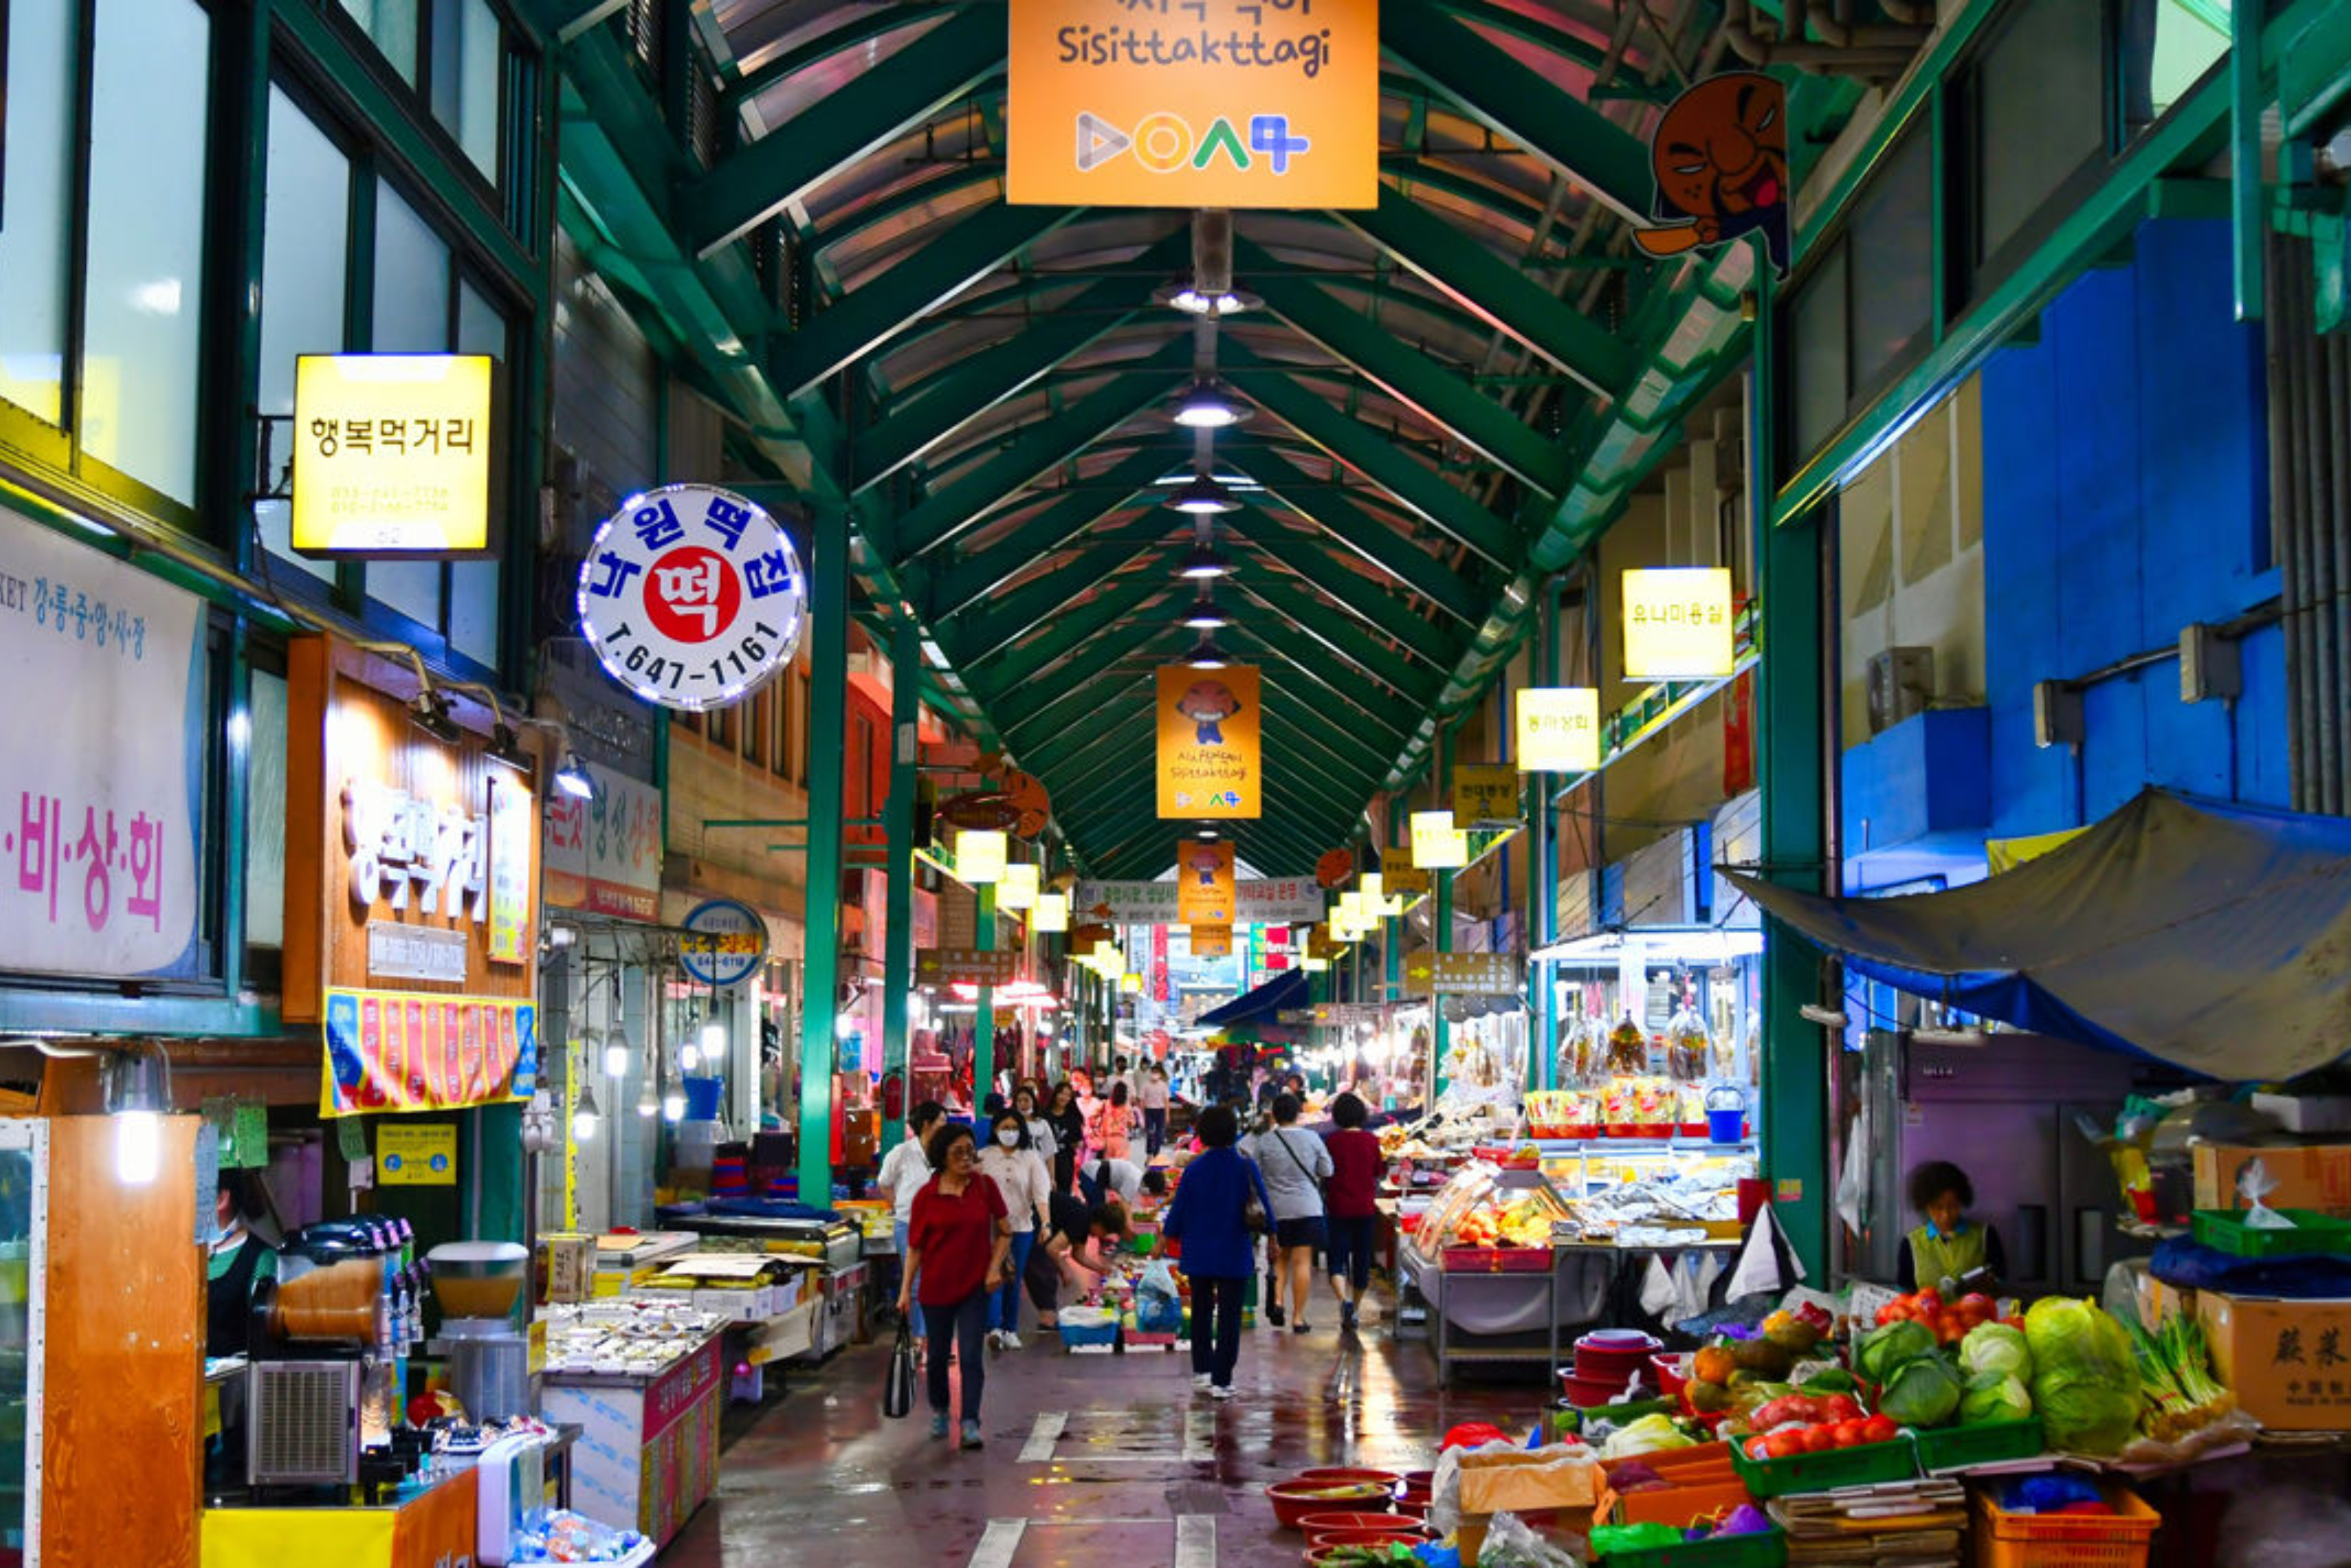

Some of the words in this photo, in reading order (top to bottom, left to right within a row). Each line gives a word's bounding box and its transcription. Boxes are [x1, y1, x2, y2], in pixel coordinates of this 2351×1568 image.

[1057, 25, 1331, 78] Sisittakttagi
[311, 418, 473, 457] 행복먹거리
[588, 496, 792, 599] 낙원떡집
[653, 556, 722, 637] 떡
[605, 622, 779, 689] T.647-1161
